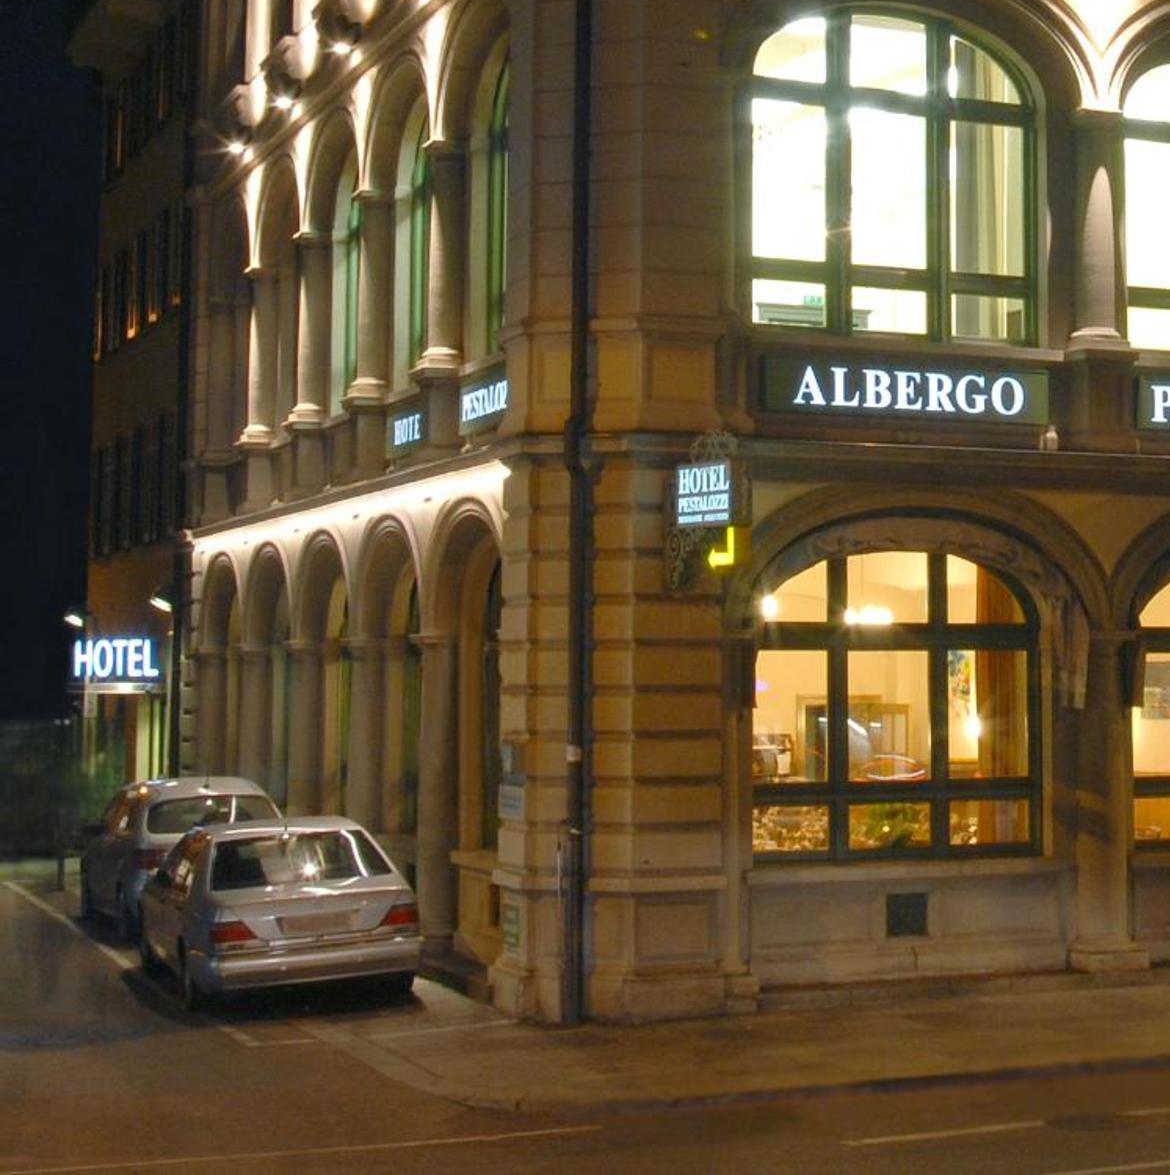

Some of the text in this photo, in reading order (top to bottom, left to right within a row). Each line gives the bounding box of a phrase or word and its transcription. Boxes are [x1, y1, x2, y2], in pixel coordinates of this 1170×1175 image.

[461, 380, 508, 422] PESTALOZ
[793, 365, 1025, 416] ALBERGO
[394, 414, 420, 446] HOTE
[678, 465, 730, 494] HOTEL
[678, 494, 729, 513] PESTALOZZI
[74, 638, 160, 678] HOTEL
